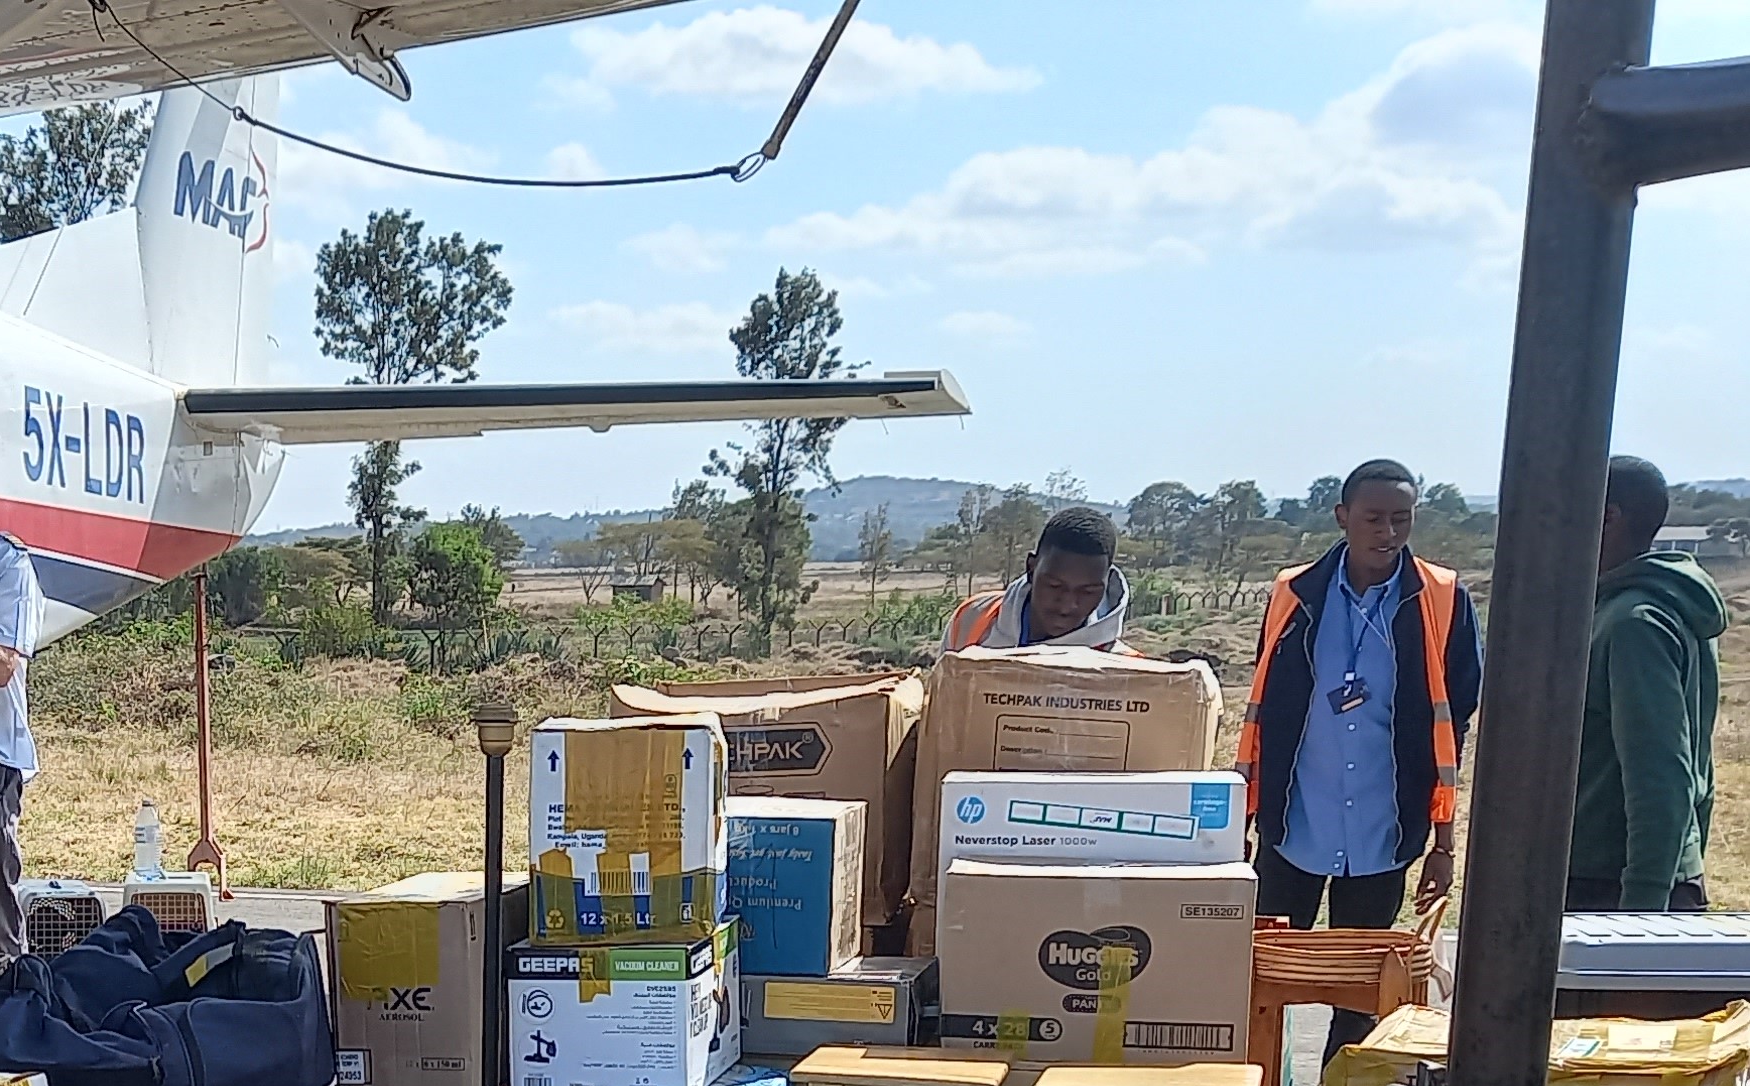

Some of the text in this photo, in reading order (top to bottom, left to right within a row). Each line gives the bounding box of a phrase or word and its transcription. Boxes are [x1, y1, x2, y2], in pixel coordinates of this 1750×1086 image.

[23, 384, 145, 504] 5X-LDR
[983, 692, 1150, 713] TECHPAK INDUSTRIES LTD
[959, 798, 983, 824] hp
[955, 835, 1018, 847] Neverstop
[1022, 836, 1056, 846] Laser
[747, 896, 802, 910] Premium
[1184, 906, 1240, 917] SE135207
[580, 912, 597, 925] 12
[518, 957, 594, 973] GEEPAS
[614, 960, 680, 972] VACUUM CLEANER
[1076, 968, 1111, 981] Gold
[379, 1013, 425, 1021] AEROSOL
[972, 1020, 1026, 1036] 4 x 28
[1044, 1022, 1055, 1034] 5
